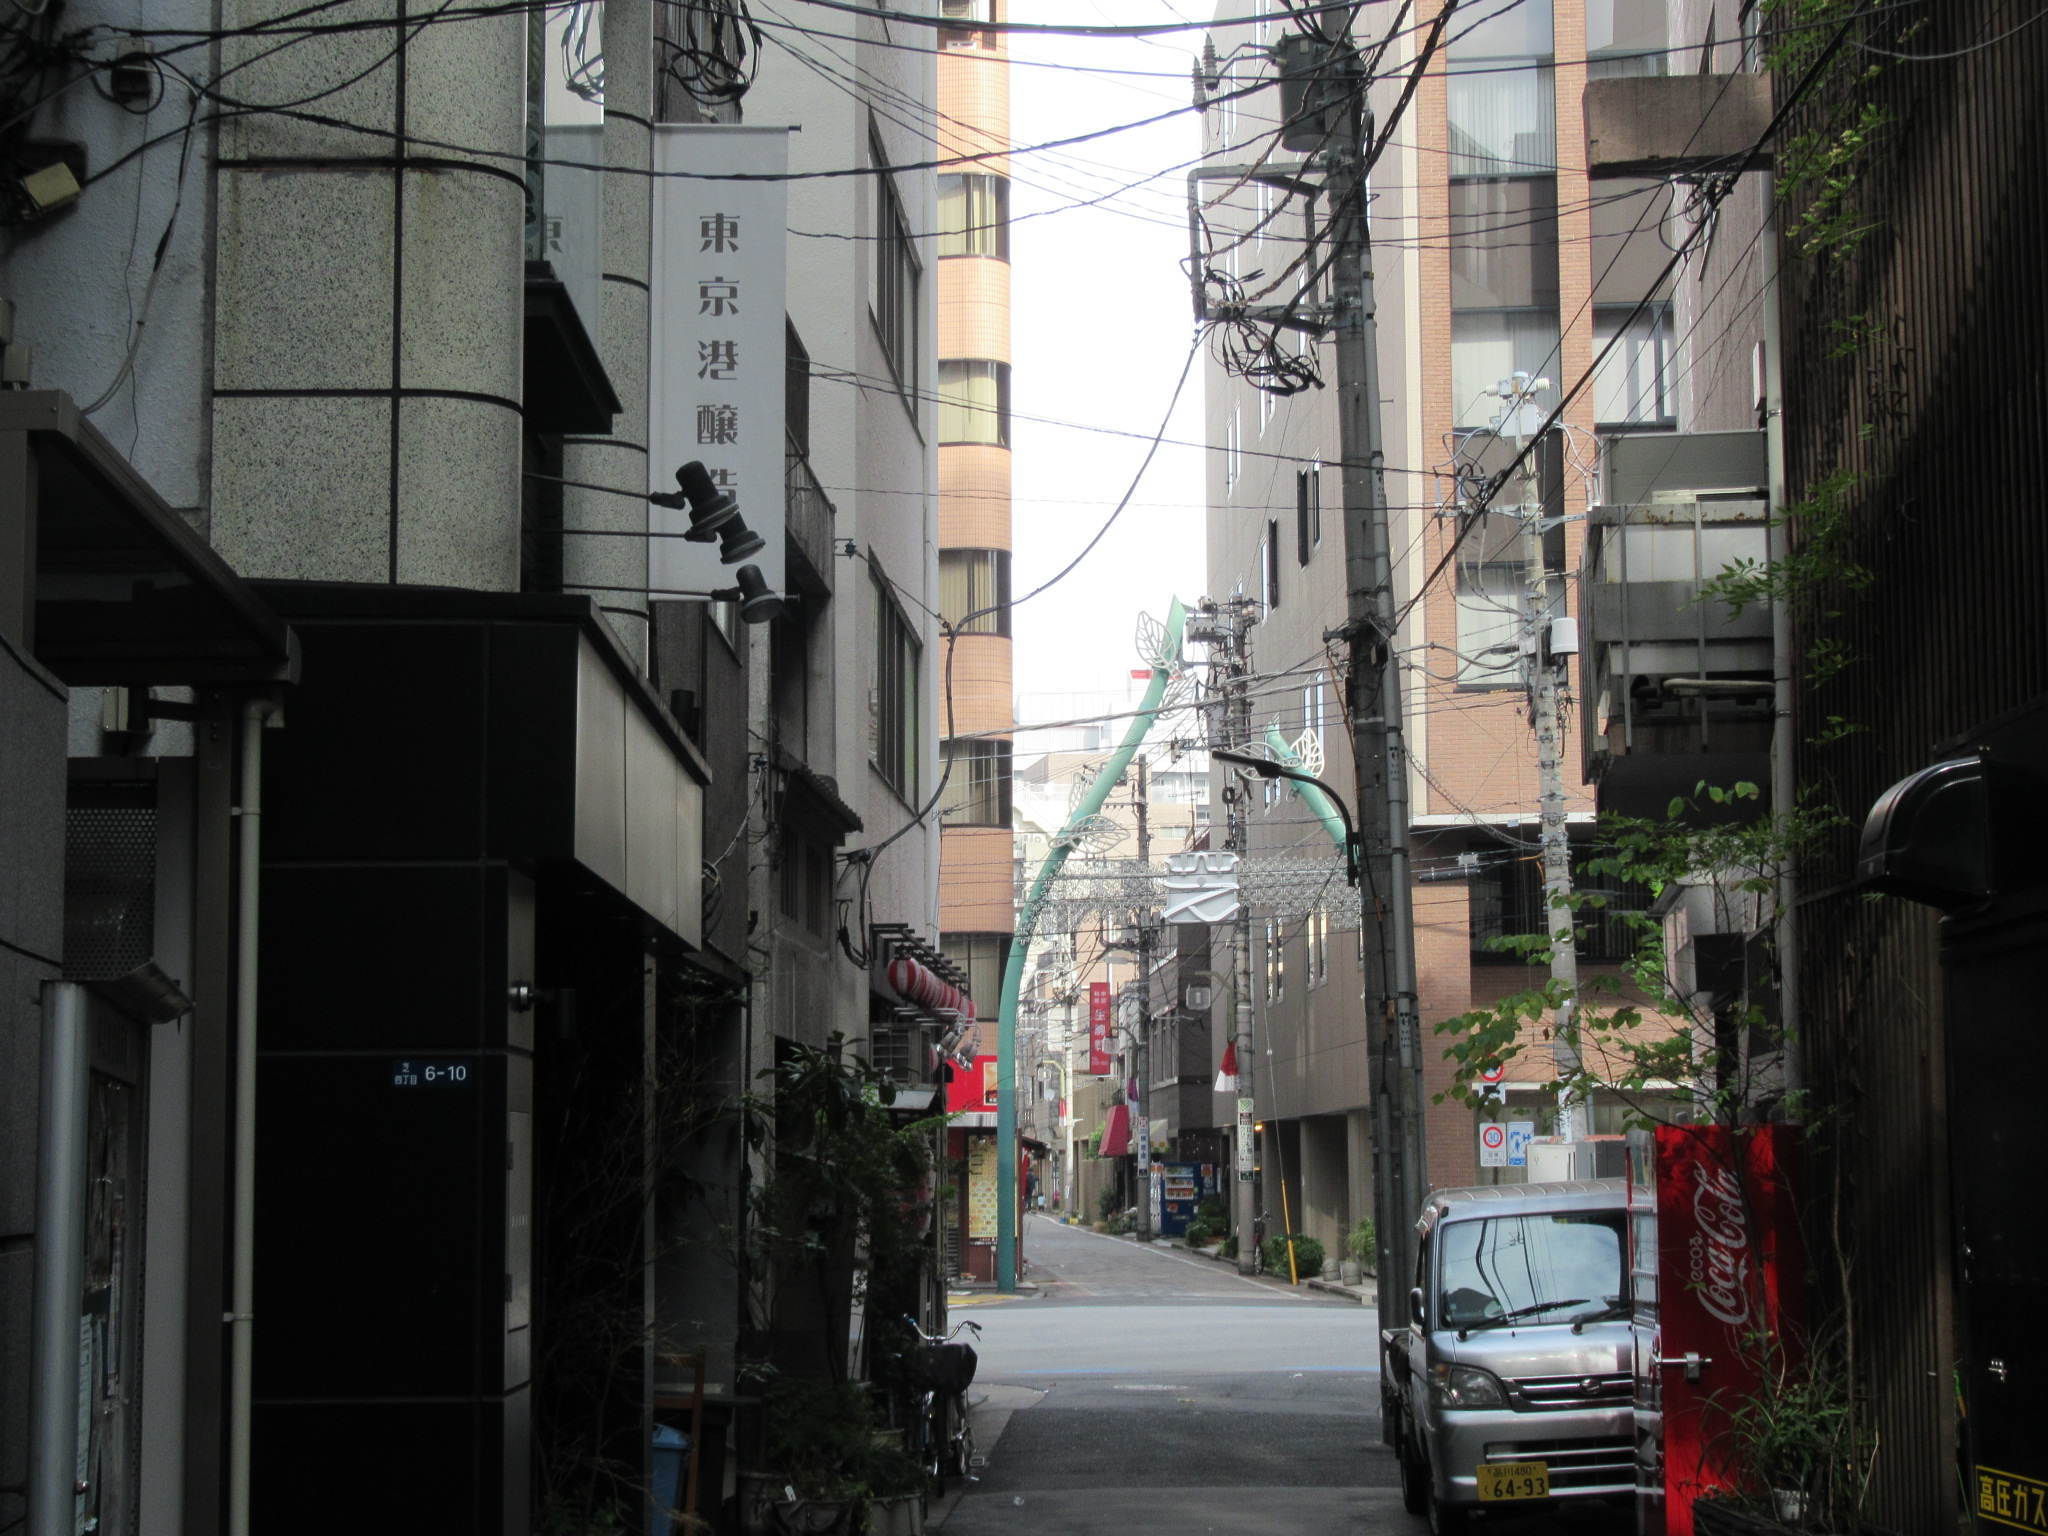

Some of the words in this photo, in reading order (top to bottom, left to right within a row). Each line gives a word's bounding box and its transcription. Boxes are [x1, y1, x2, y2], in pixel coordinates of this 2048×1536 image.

[394, 1074, 418, 1085] 四丁目
[425, 1065, 467, 1081] 6-10
[1488, 1132, 1499, 1143] 30
[1693, 1158, 1749, 1325] Coca-Cola
[1494, 1477, 1545, 1498] 64-93
[1979, 1475, 2047, 1528] 高圧ガス
